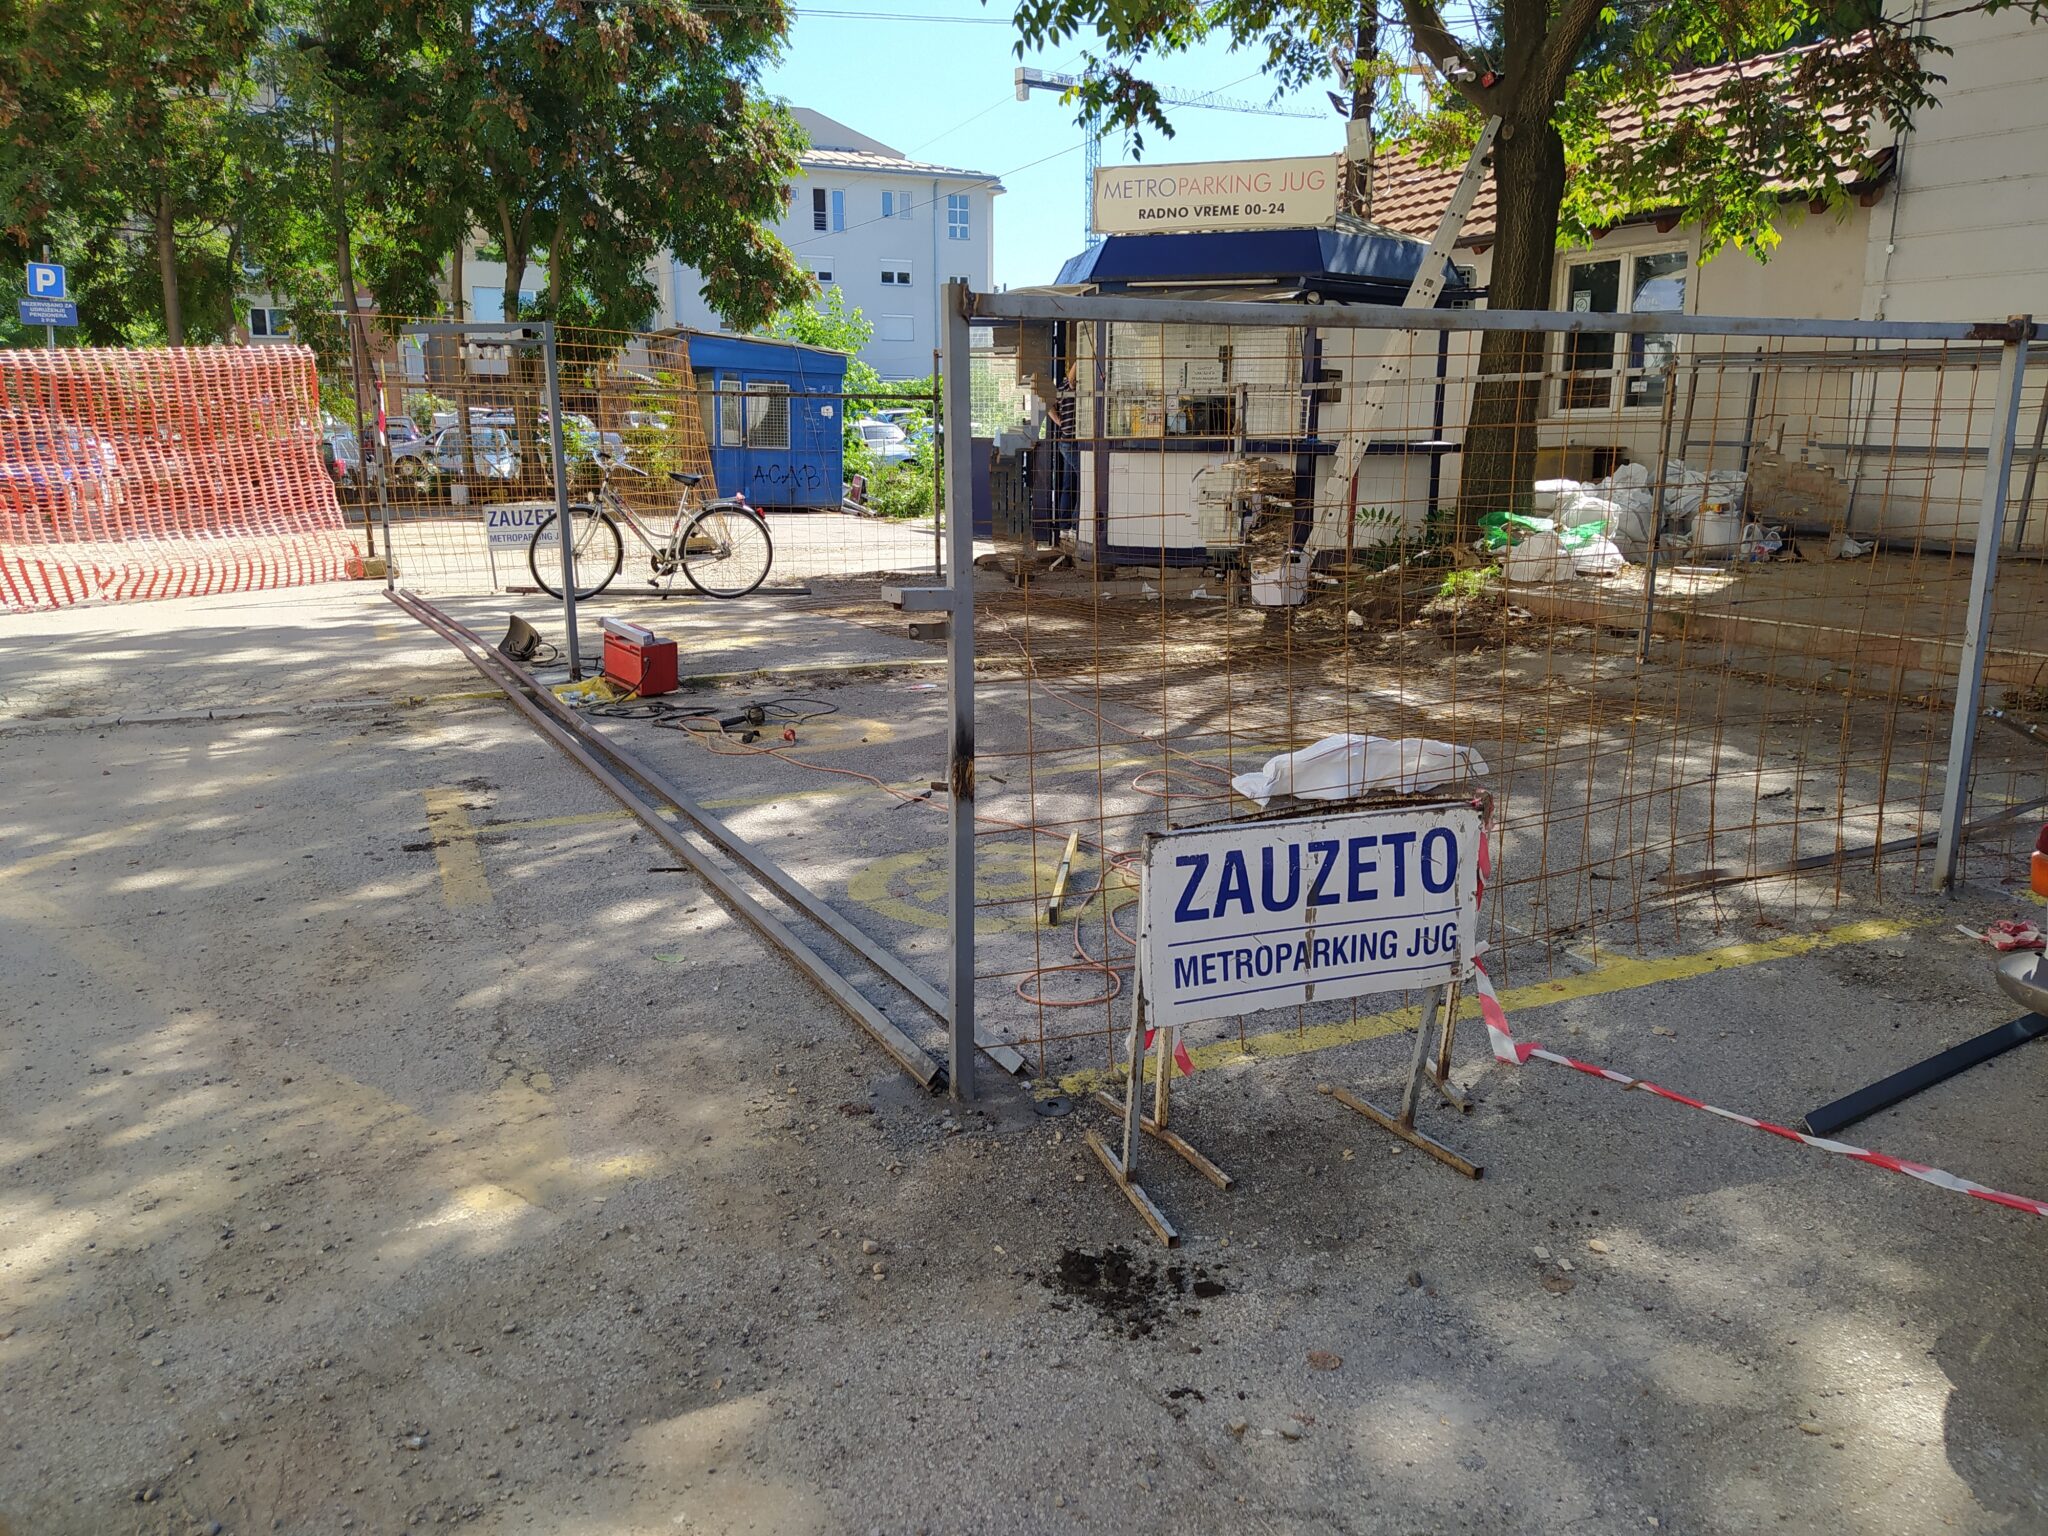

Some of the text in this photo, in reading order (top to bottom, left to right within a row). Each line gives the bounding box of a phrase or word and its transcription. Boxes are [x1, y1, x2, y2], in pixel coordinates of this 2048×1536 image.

[1103, 170, 1326, 200] METROPARKING JUG
[1138, 202, 1286, 220] RADNO VREME 00-24
[36, 267, 56, 292] P
[488, 508, 556, 527] ZAUZET
[1174, 826, 1459, 924] ZAUZETO
[1174, 922, 1458, 990] METROPARKING JUG
